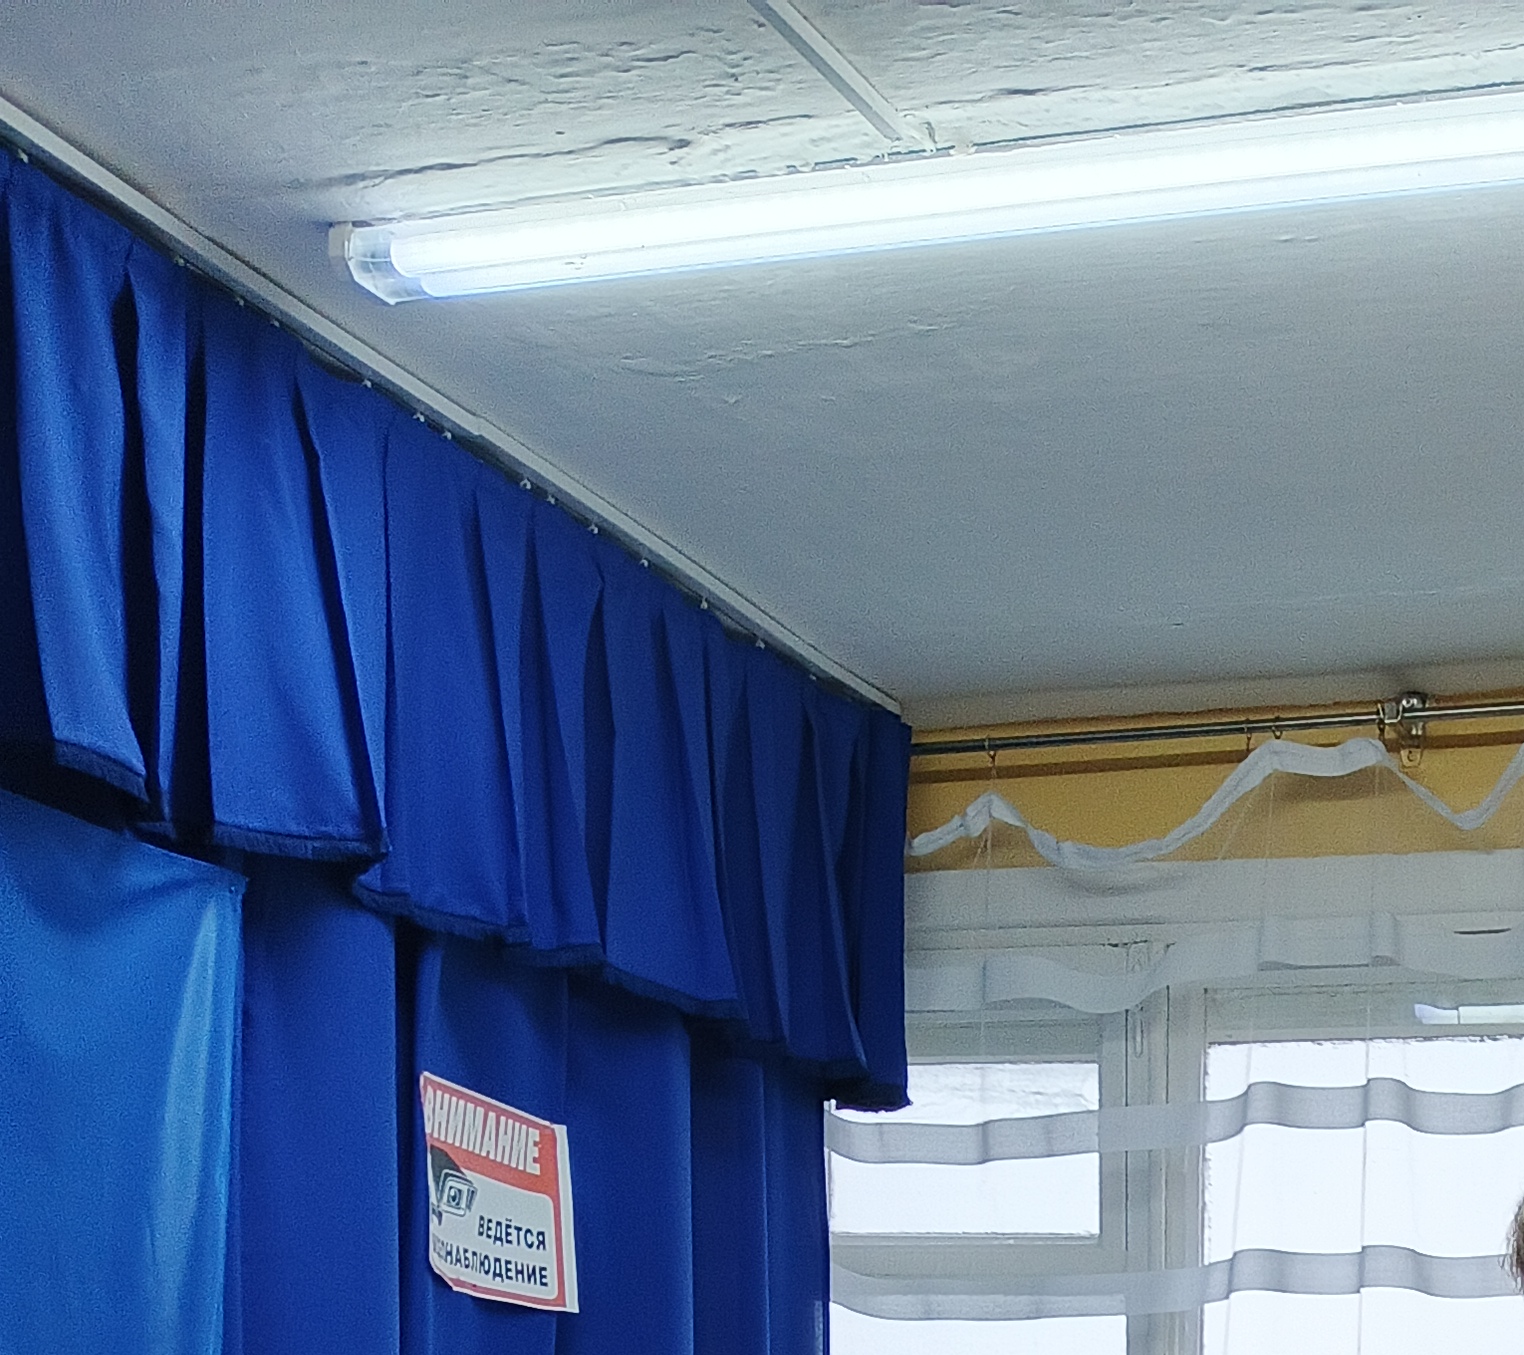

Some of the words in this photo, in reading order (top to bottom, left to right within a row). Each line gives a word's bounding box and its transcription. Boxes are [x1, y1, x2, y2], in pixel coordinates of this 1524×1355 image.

[424, 1084, 541, 1176] ВНИМАНИЕ
[477, 1214, 547, 1251] ВЕДЁТСЯ
[433, 1233, 548, 1287] НАБЛЮДЕНИЕ
